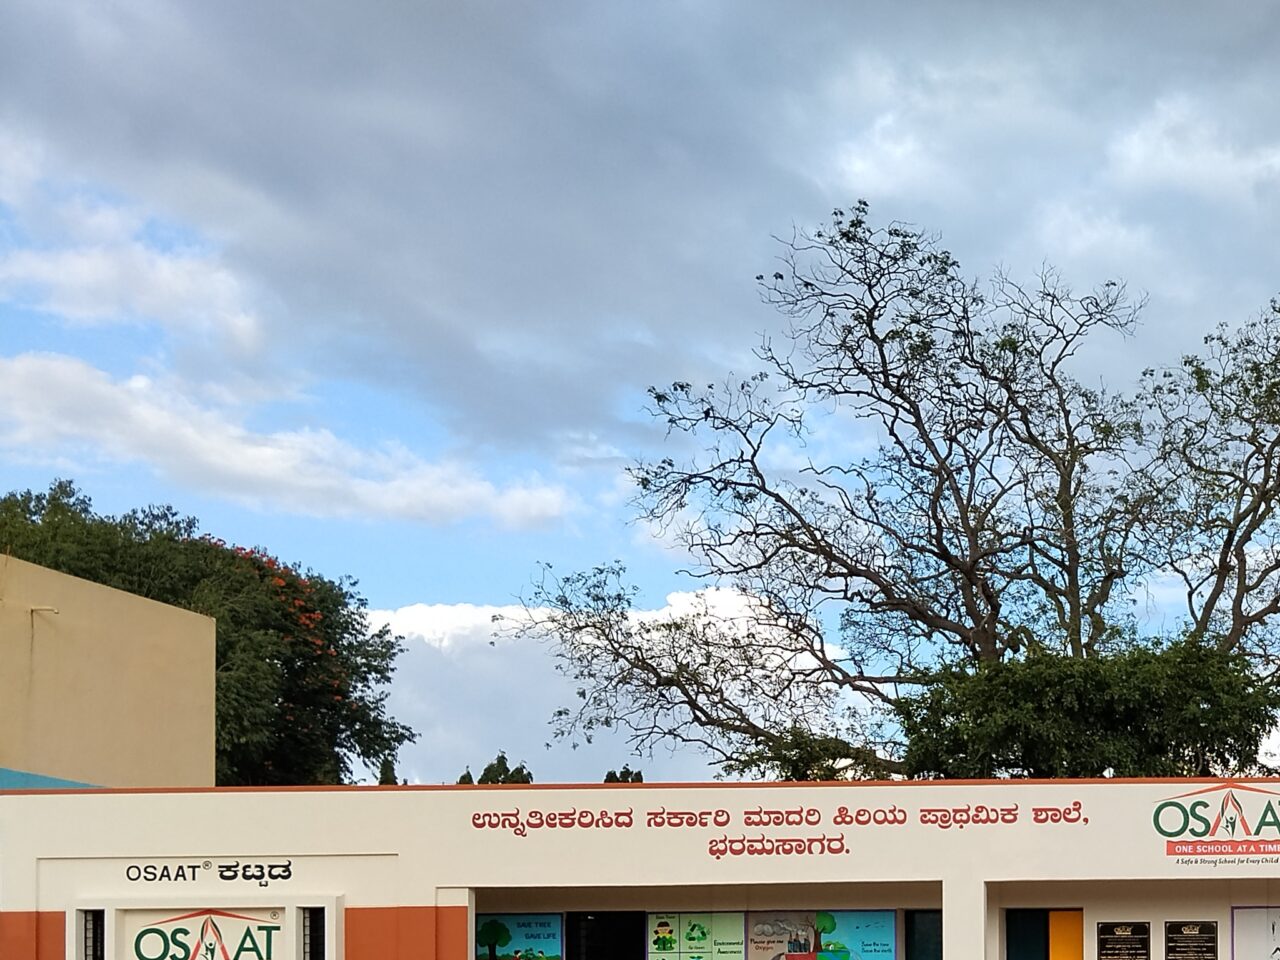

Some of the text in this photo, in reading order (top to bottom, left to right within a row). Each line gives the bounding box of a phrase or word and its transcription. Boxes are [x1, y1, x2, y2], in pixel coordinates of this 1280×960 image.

[471, 800, 1089, 837] ಉನ್ನತೀಕರಿಸಿದ ಸರ್ಕಾರಿ ಮಾದರಿ ಹಿರಿಯ ಪ್ರಾಥಮಿಕ ಶಾಲೆ,
[708, 833, 850, 860] ಭರಮಸಾಗರ.
[1175, 845, 1193, 853] ONE
[1196, 845, 1233, 853] SCHOOL
[1237, 844, 1248, 852] AT
[1248, 844, 1256, 852] A
[218, 860, 292, 887] ಕಟ್ಟಡ
[1181, 858, 1194, 866] Safe
[1199, 858, 1218, 867] Strong
[1237, 857, 1246, 866] for
[1246, 857, 1261, 865] Every
